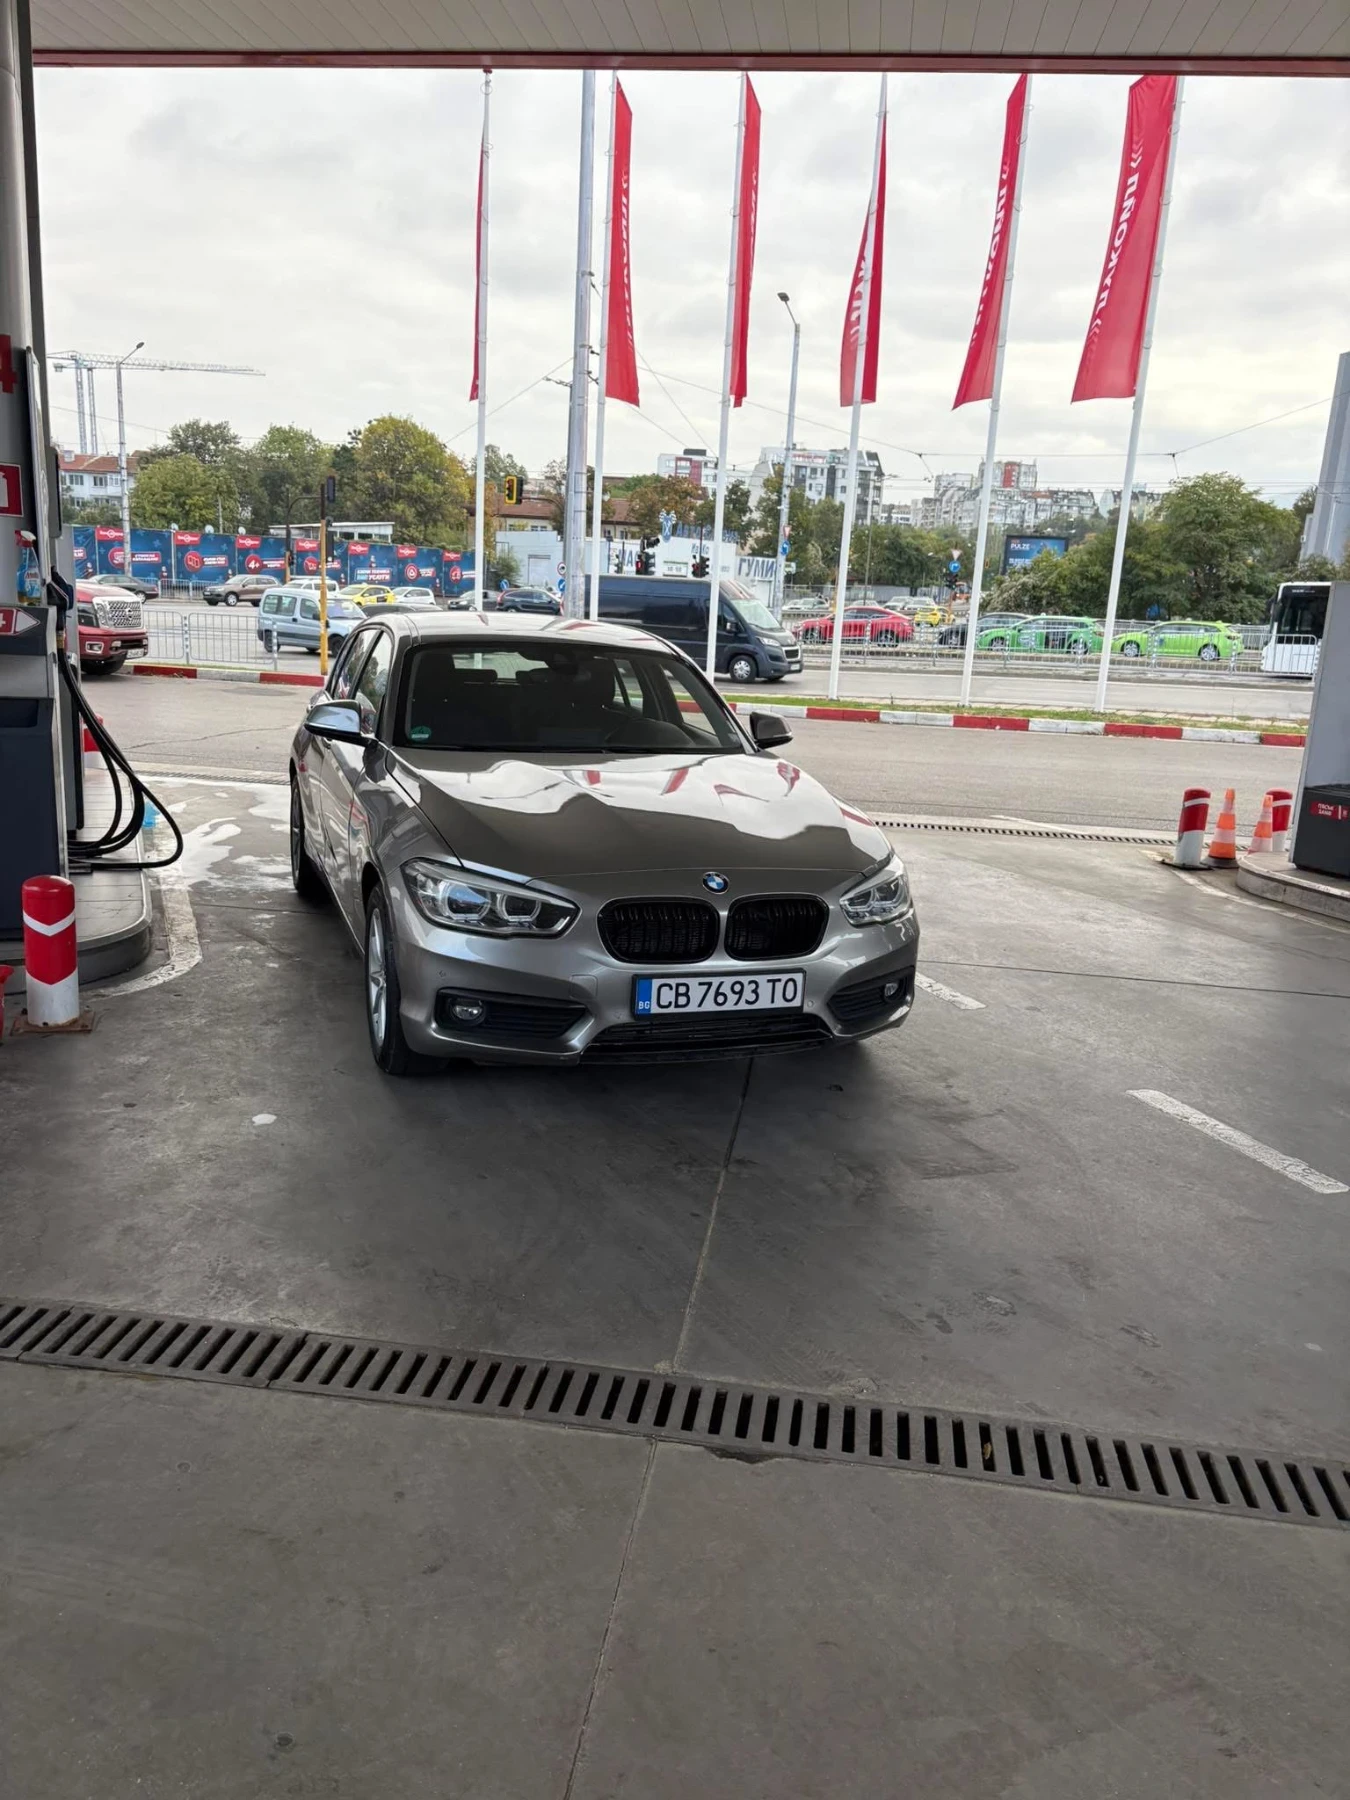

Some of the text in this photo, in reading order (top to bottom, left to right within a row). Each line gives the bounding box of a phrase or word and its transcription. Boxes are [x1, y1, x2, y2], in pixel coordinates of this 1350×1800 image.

[738, 558, 775, 578] ГУМИ
[656, 982, 691, 1009] CB
[697, 979, 760, 1008] 7693
[638, 1001, 650, 1010] BG
